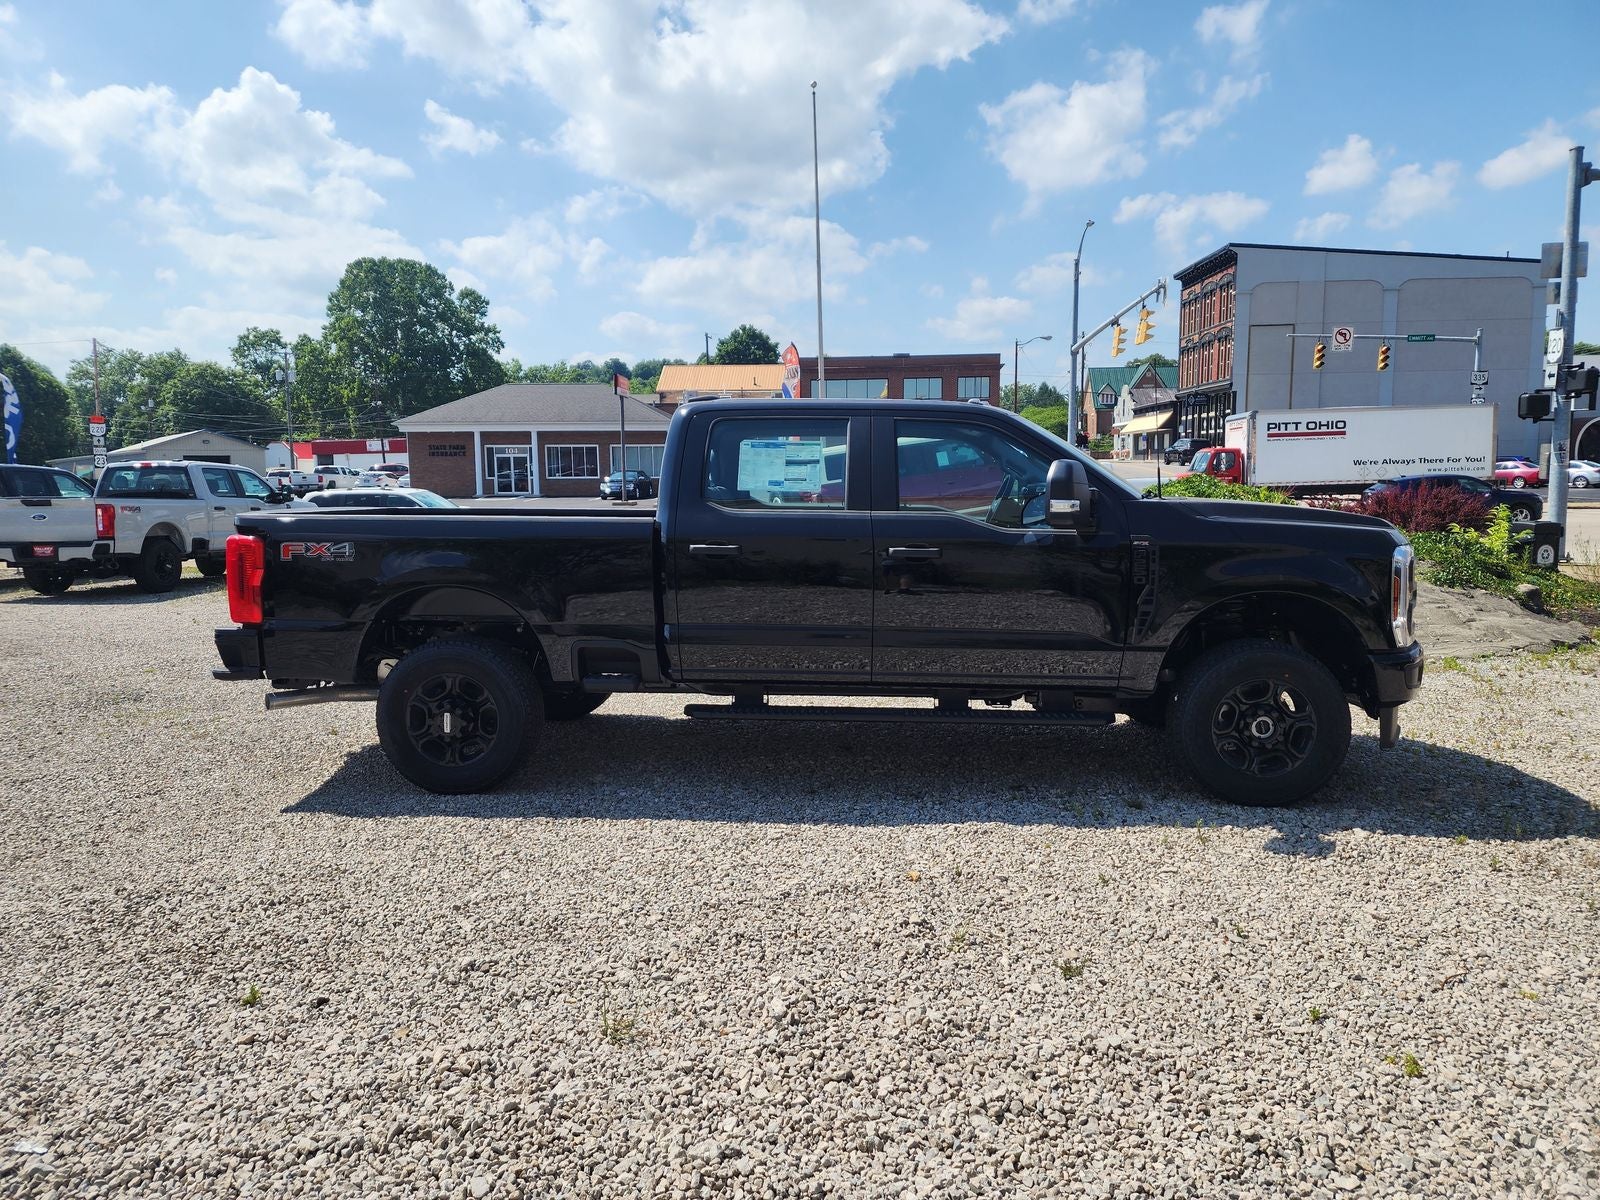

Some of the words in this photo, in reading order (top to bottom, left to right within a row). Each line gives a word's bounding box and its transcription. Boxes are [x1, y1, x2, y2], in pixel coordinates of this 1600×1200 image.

[1267, 422, 1302, 431] PITT
[1306, 420, 1346, 430] OHIO
[95, 457, 106, 465] 23
[1382, 458, 1416, 466] Always
[281, 542, 355, 561] FX4
